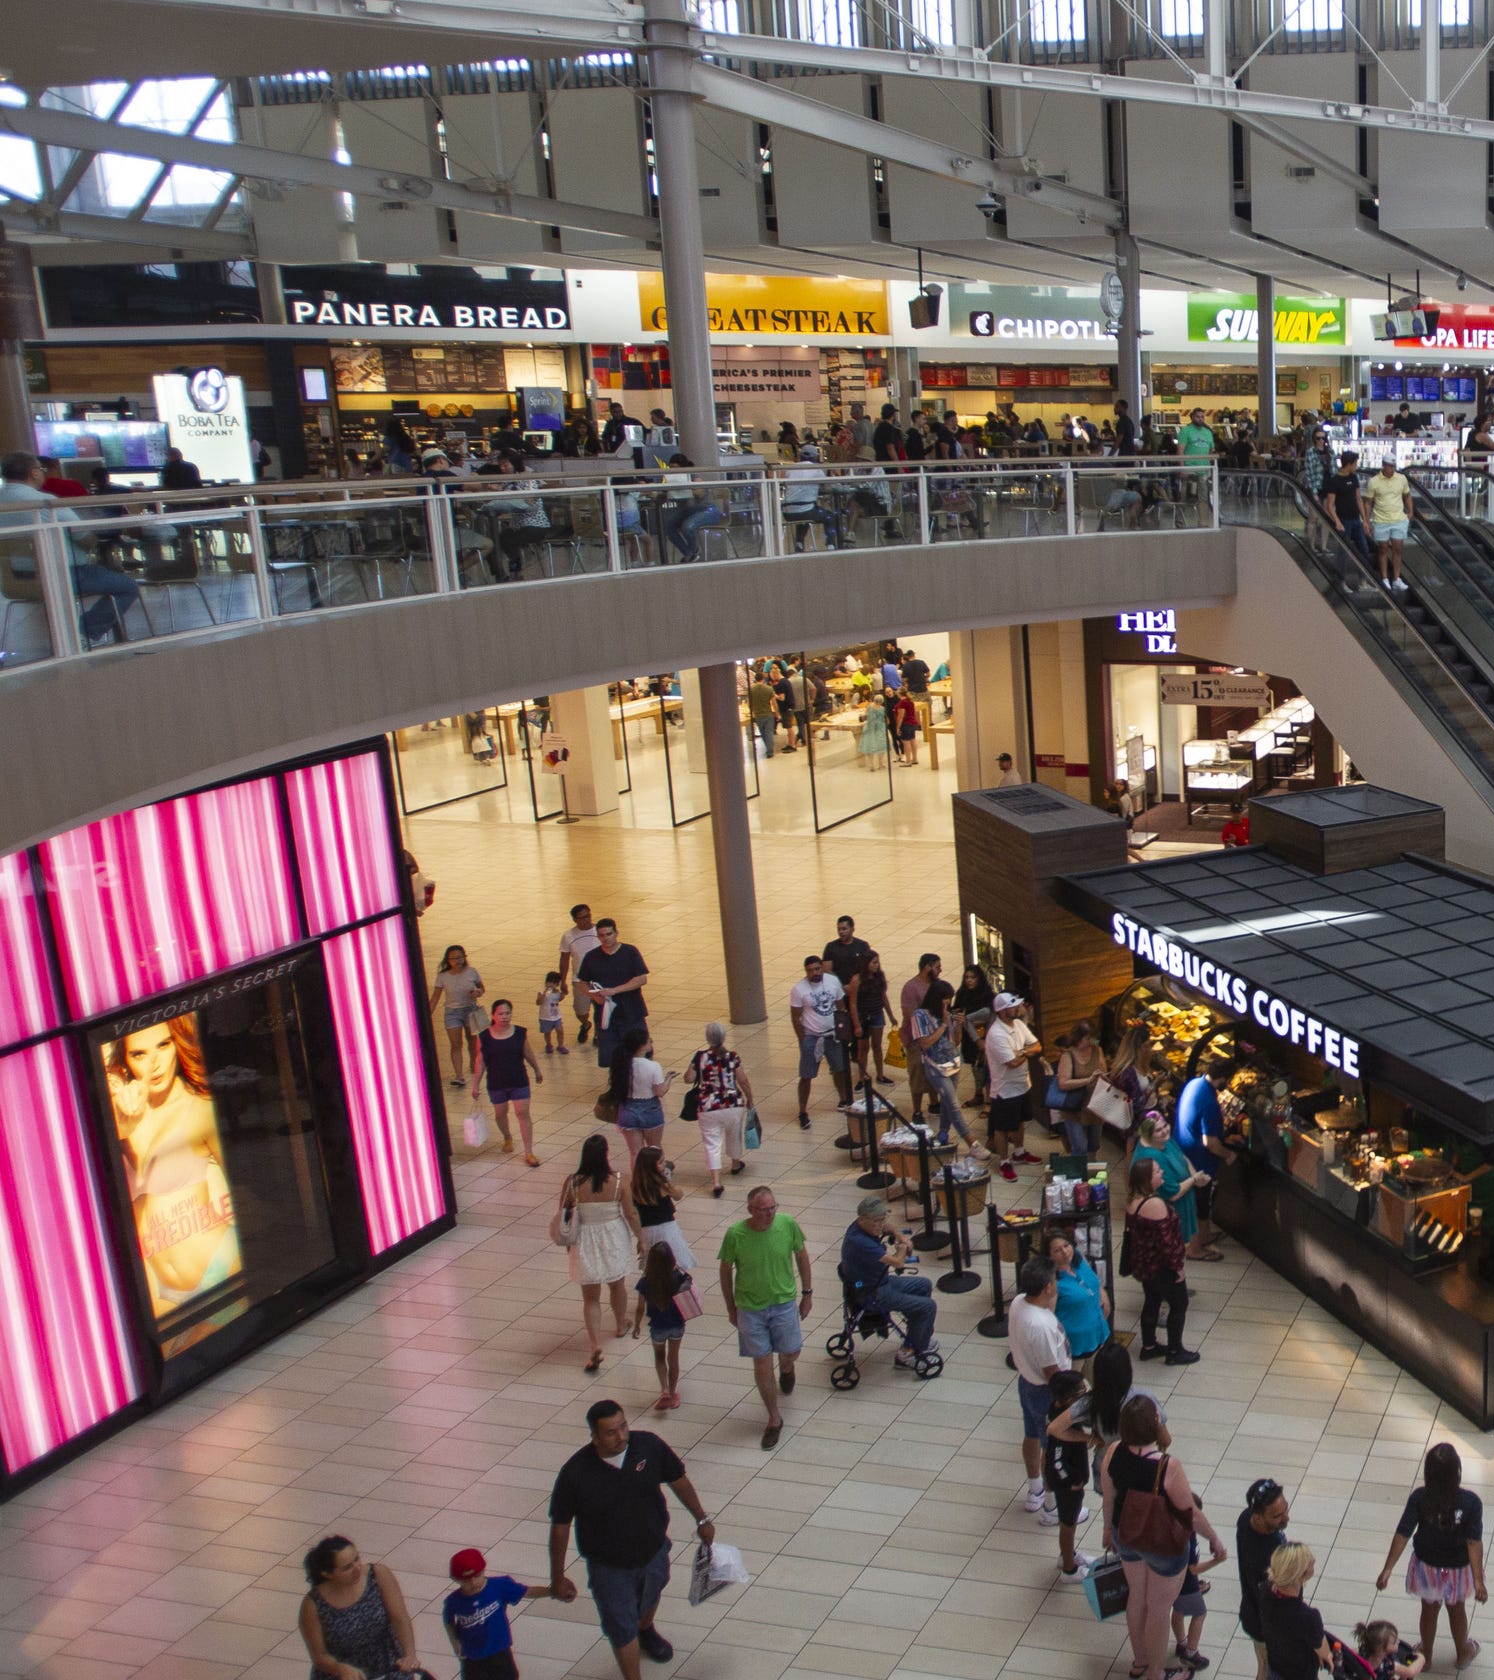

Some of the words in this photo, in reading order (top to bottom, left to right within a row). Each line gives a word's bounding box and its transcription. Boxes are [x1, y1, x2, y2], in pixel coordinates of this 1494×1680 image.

[293, 302, 441, 326] PANERA
[454, 305, 568, 328] BREAD
[651, 305, 766, 331] GEAT
[771, 308, 879, 333] STEAK
[712, 369, 759, 378] ERICA'S
[762, 368, 812, 378] PREMIER
[713, 383, 796, 392] CHEESESTEAK
[529, 396, 550, 408] Sprint
[178, 414, 215, 428] BOBA
[213, 413, 240, 427] TEA
[187, 429, 233, 437] COMPANY
[113, 986, 226, 1037] VICTORIA'S
[232, 959, 298, 994] SECRET
[1113, 913, 1248, 1014] STARBUCKS
[1252, 989, 1360, 1078] COFFEE
